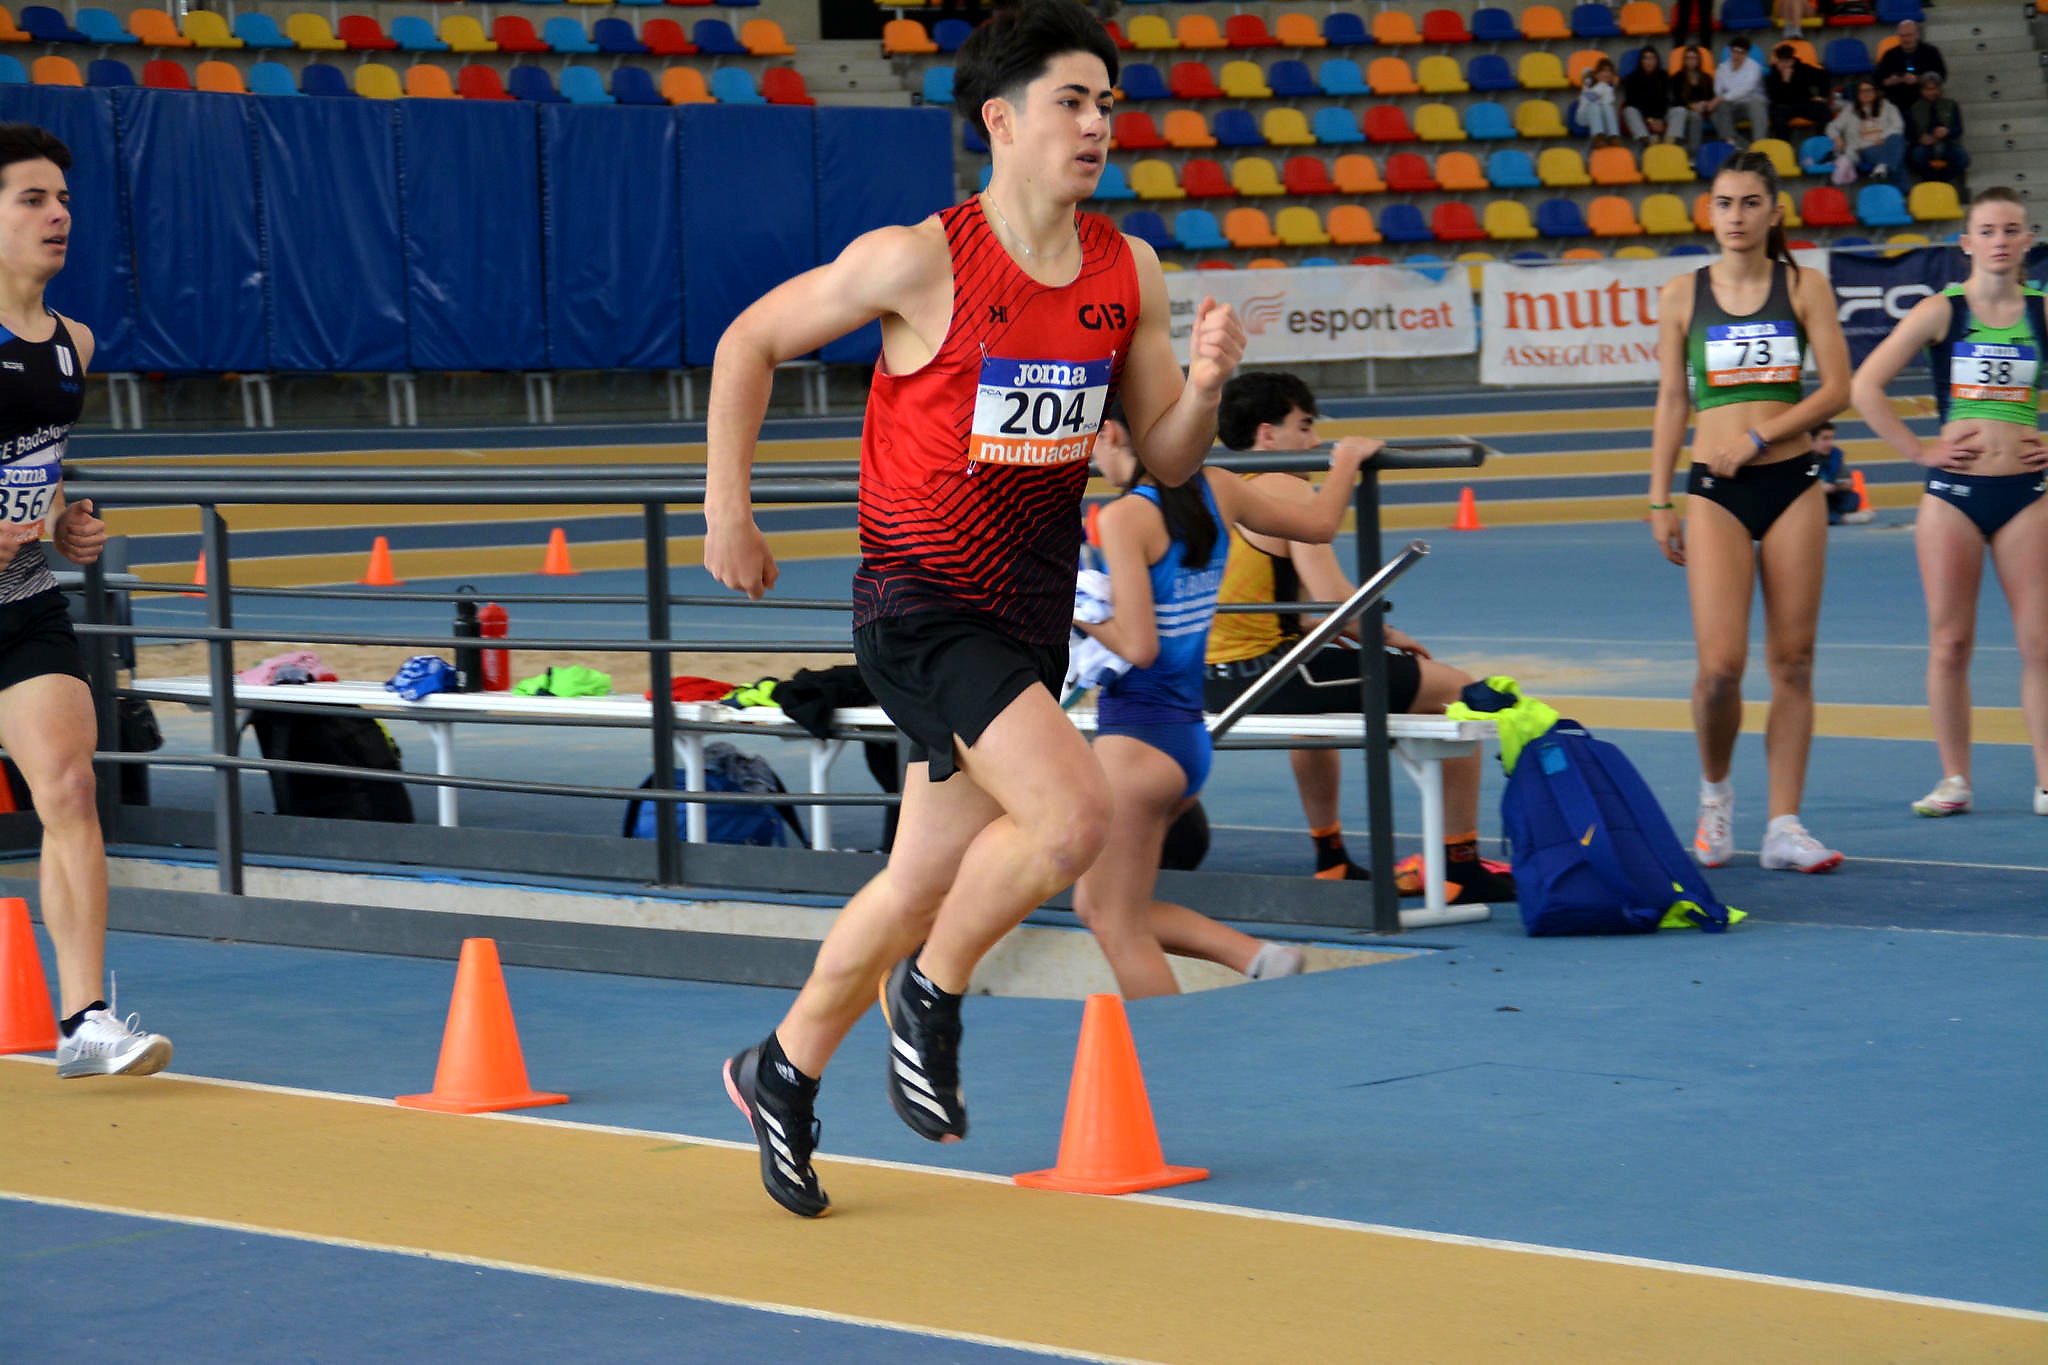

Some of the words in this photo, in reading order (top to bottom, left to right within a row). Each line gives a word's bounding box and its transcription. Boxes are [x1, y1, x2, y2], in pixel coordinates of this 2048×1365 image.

[1288, 302, 1455, 340] esportcat
[1734, 340, 1772, 367] 73
[1978, 360, 2012, 385] 38
[1000, 391, 1086, 435] 204
[15, 421, 75, 456] Badalo
[979, 436, 1089, 464] mutuacat
